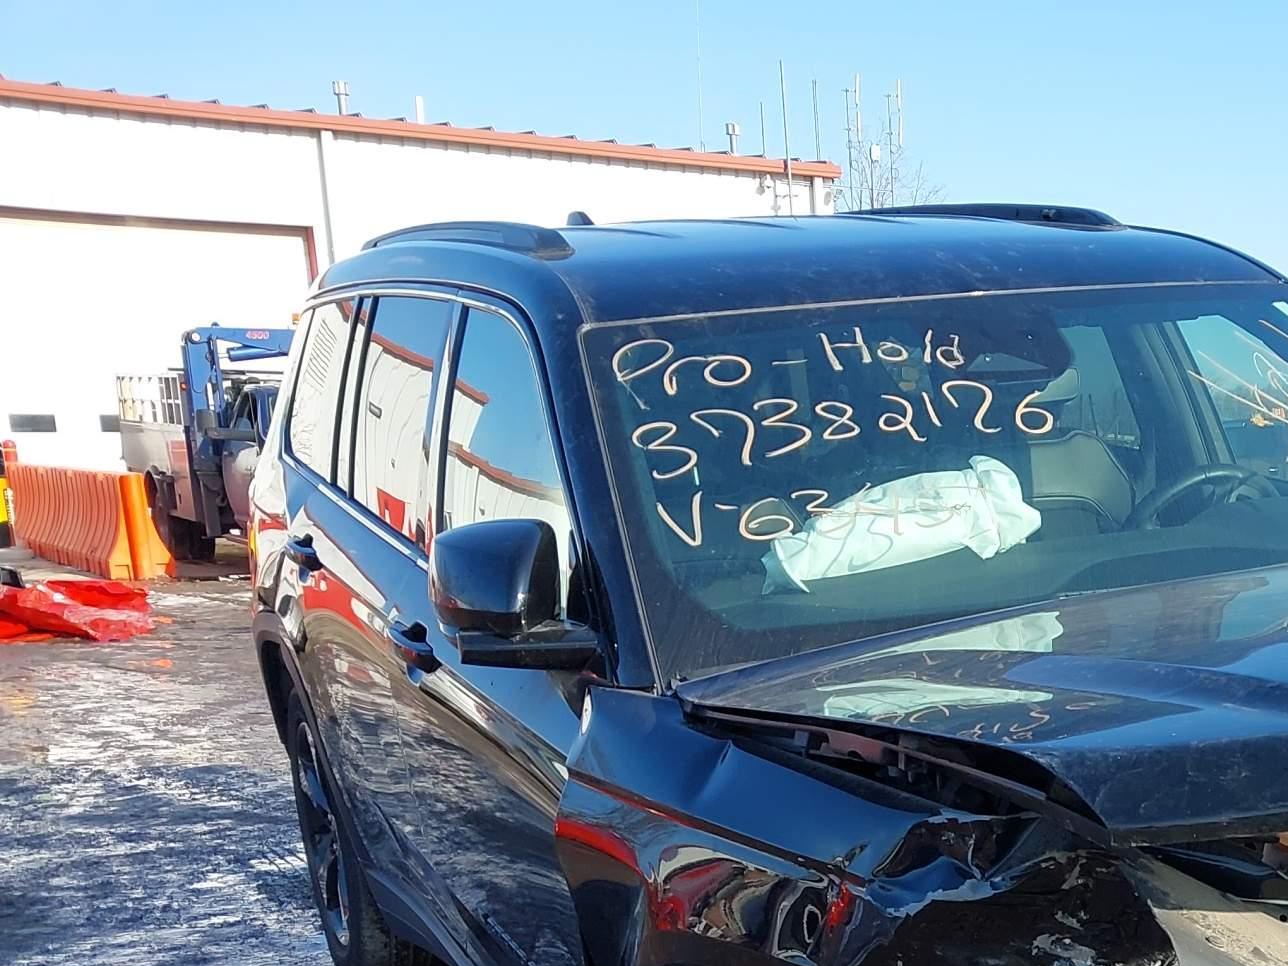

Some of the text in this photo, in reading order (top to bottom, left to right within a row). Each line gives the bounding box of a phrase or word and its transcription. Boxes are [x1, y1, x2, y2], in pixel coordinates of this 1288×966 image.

[612, 338, 752, 410] Pro
[817, 326, 966, 371] Hold
[631, 380, 1055, 480] 37382176
